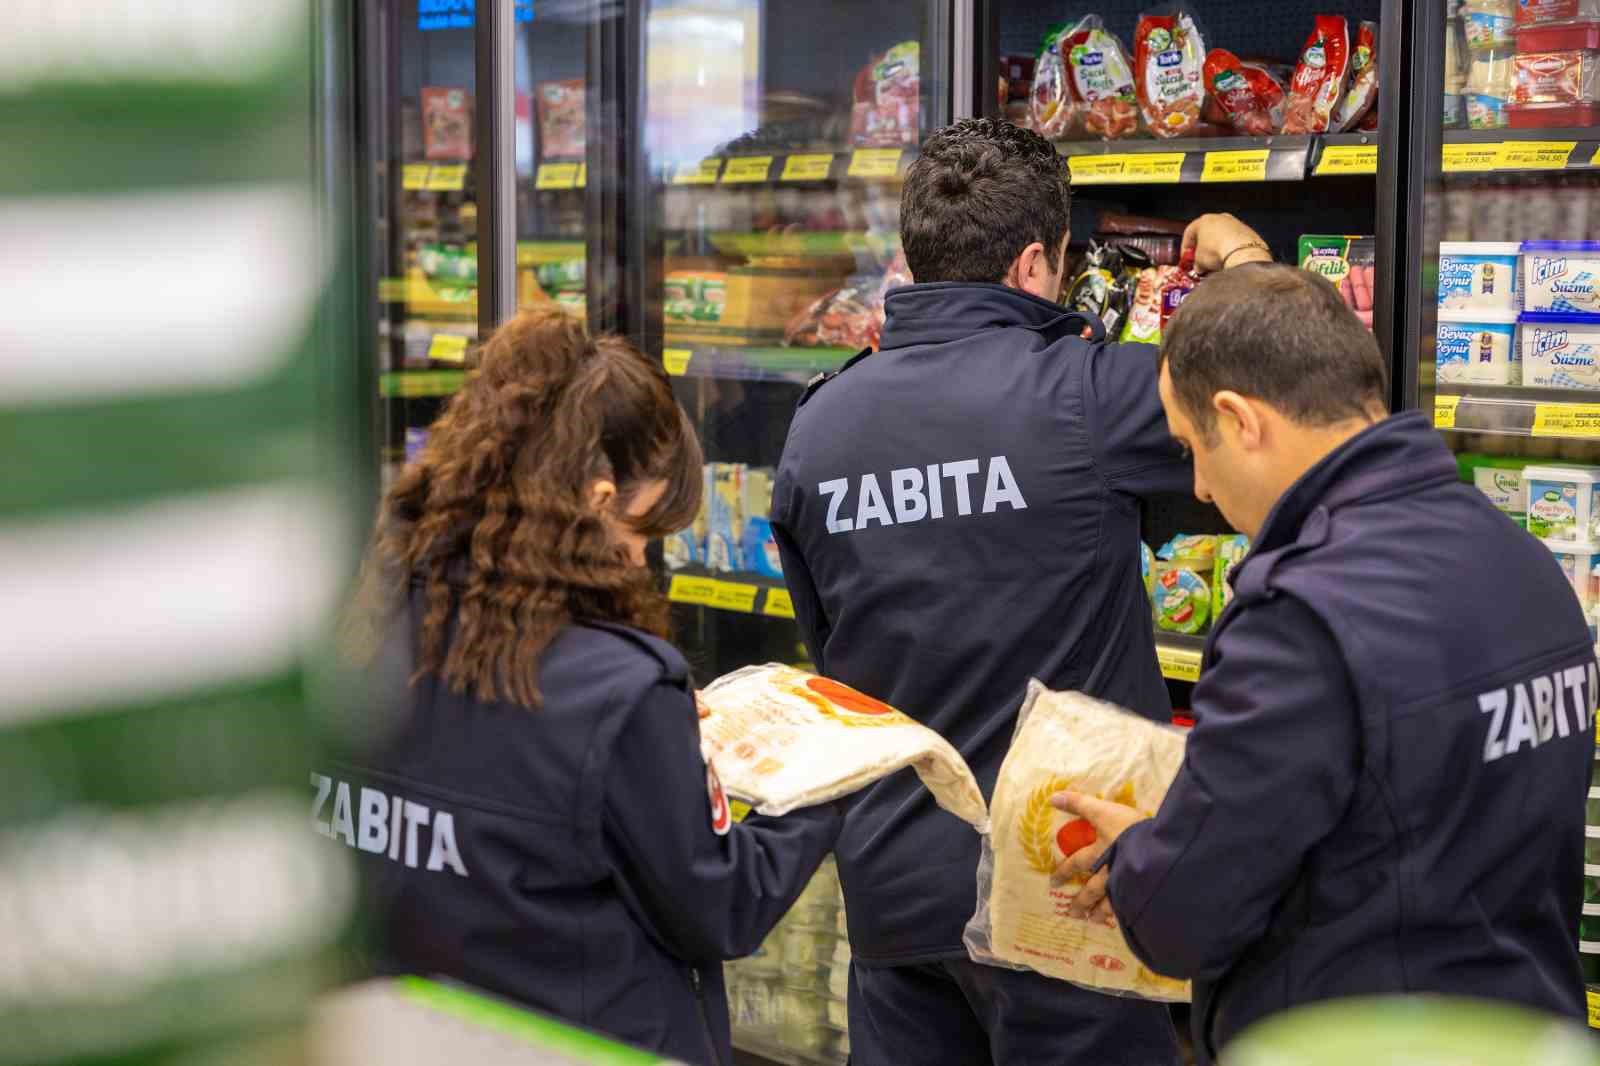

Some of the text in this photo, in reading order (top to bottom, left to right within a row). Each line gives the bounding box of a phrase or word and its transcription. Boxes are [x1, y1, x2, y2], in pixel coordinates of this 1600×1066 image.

[1441, 258, 1474, 272] Beyaz
[1550, 279, 1593, 294] Süzme
[1439, 325, 1473, 341] Beyaz
[1550, 352, 1595, 366] Süzme
[818, 455, 1029, 534] ZABITA
[1478, 662, 1598, 763] ZABITA
[310, 771, 468, 877] ZABITA
